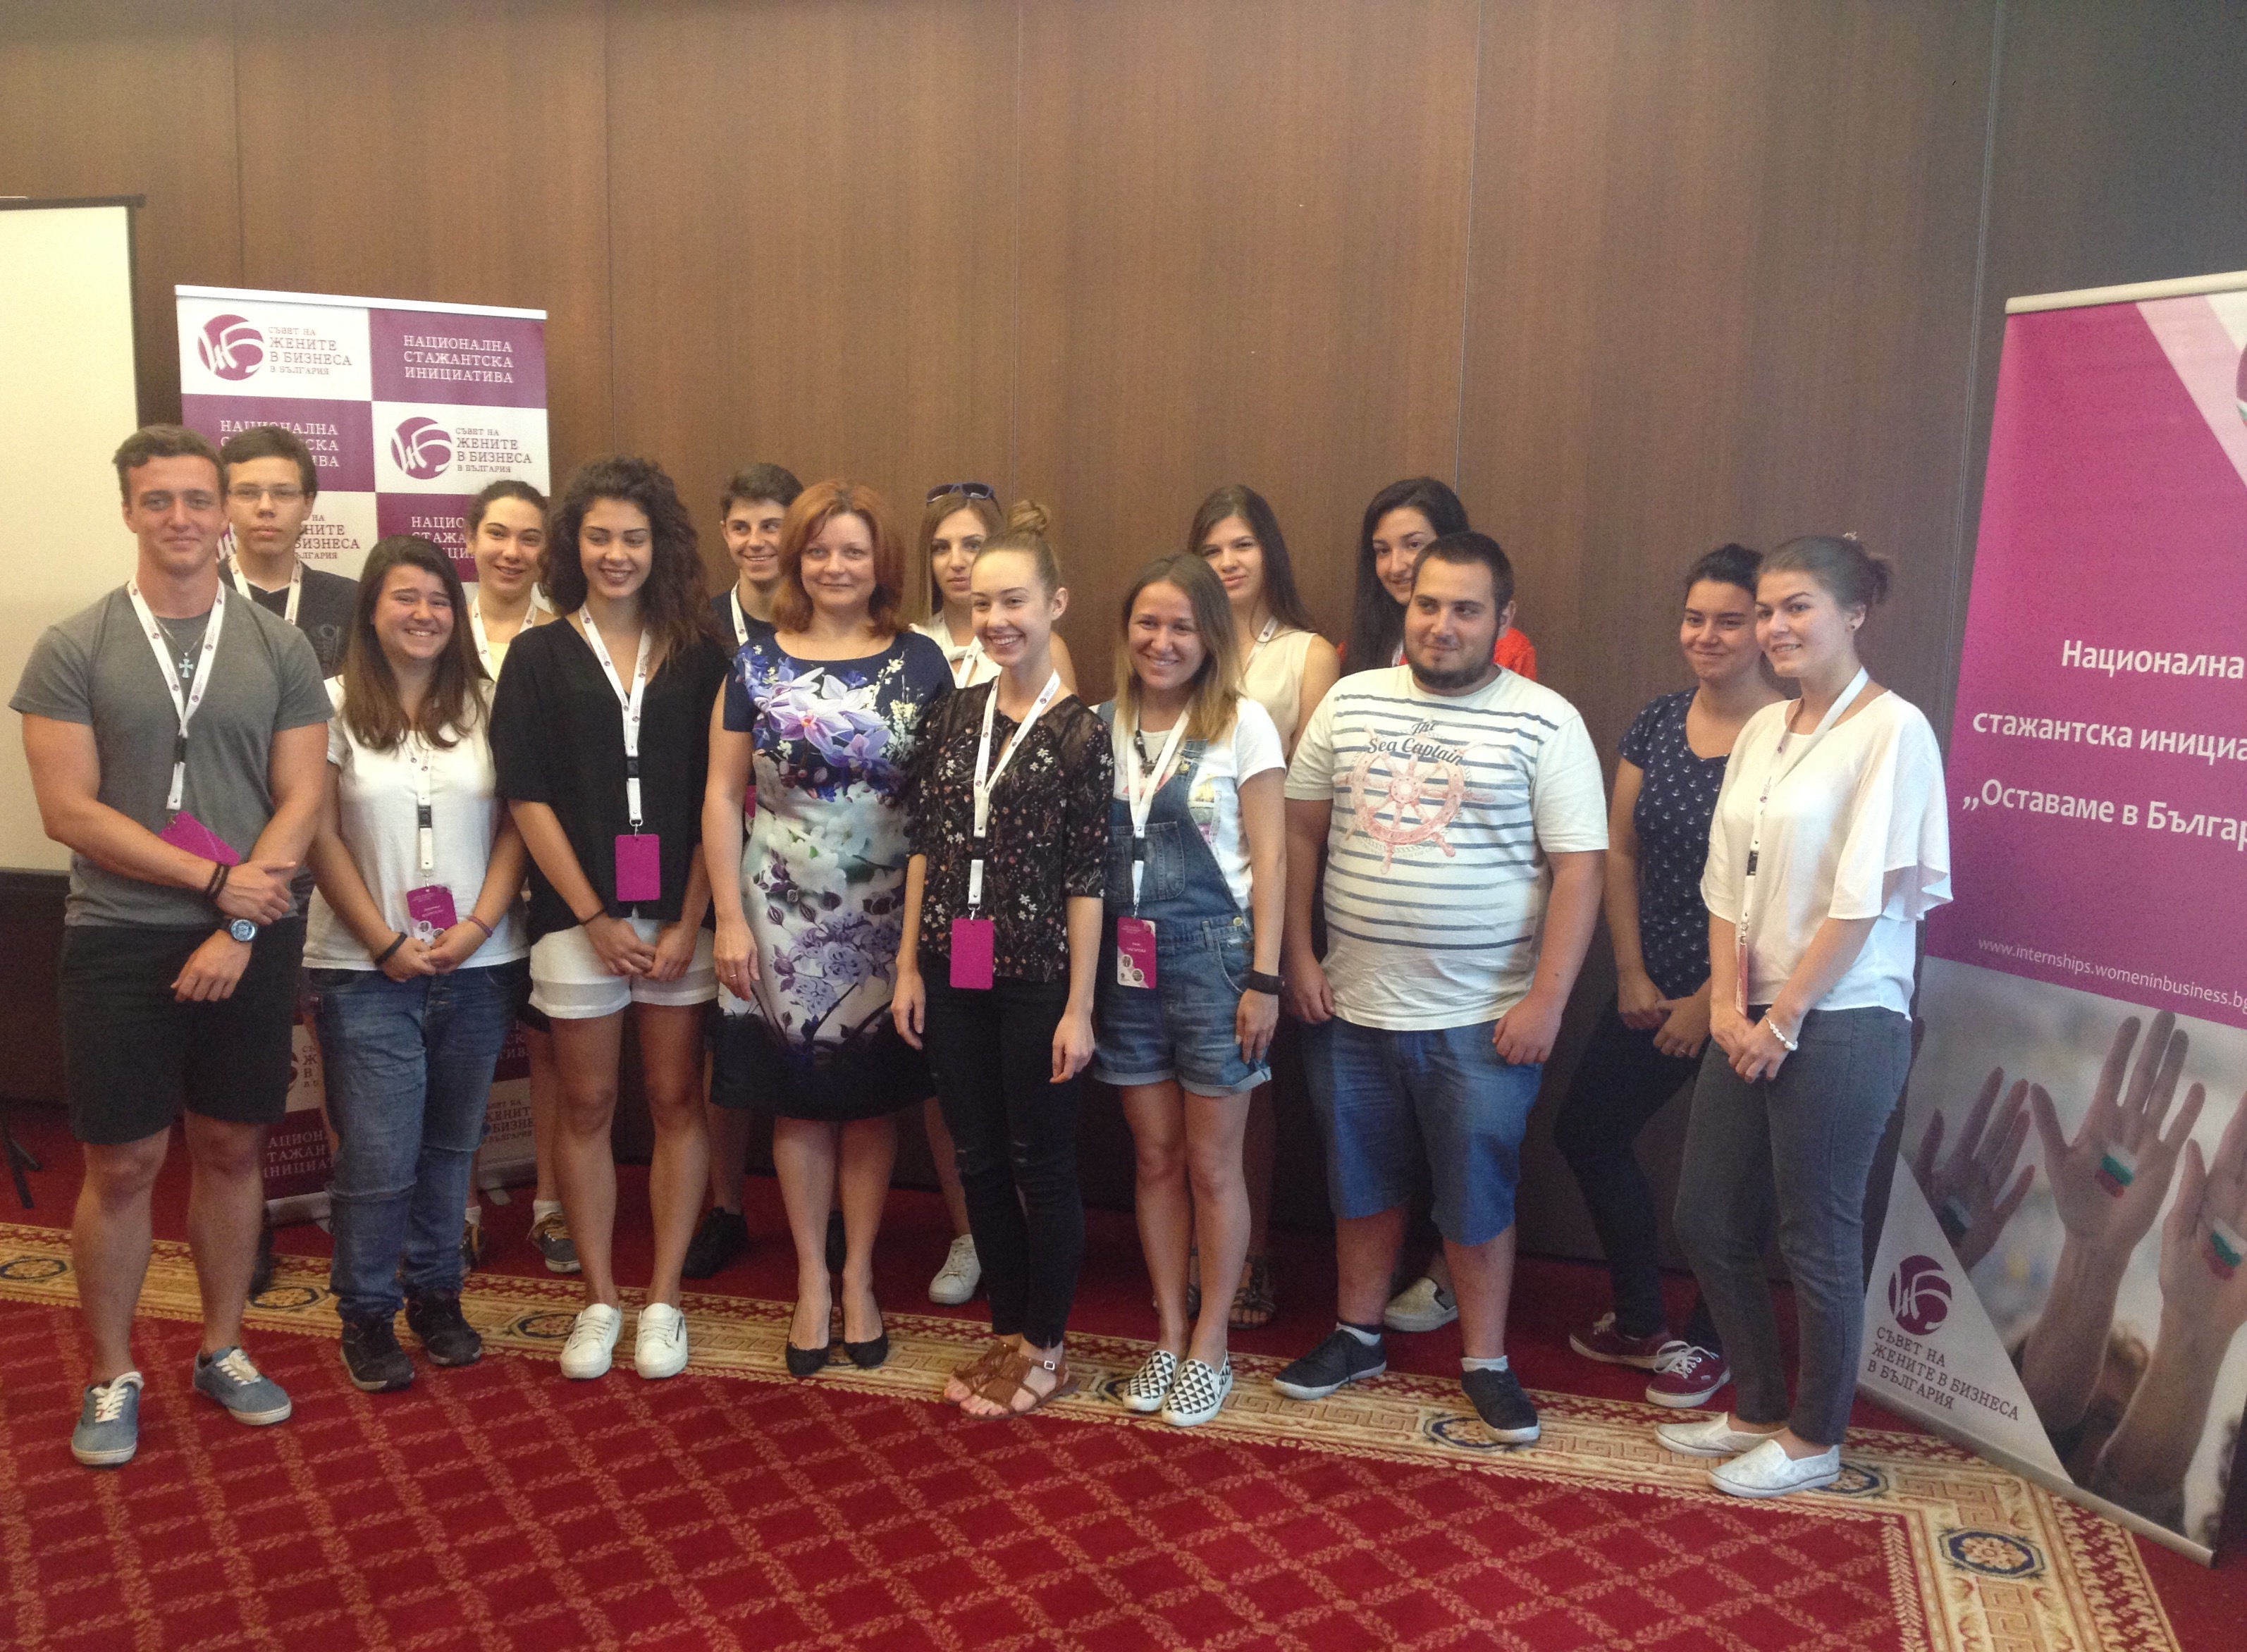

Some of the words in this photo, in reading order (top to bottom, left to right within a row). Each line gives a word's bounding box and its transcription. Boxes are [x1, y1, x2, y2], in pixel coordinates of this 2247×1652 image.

[268, 326, 299, 335] СЪВЕТ
[269, 337, 337, 351] ЖЕНИТЕ
[403, 335, 513, 352] НАЦИОНАЛНА
[269, 351, 278, 362] В
[283, 352, 352, 366] БИЗНЕСА
[404, 351, 514, 368] СТАЖАНТСКА
[279, 366, 330, 375] БЪЛГАРИЯ
[405, 366, 514, 383] ИНИЦИАТИВА
[456, 438, 518, 450] ЖЕНИТЕ
[457, 451, 465, 462] В
[469, 452, 532, 464] БИЗНЕСА
[465, 464, 512, 473] БЪЛГАРИЯ
[304, 524, 345, 536] НИТЕ
[411, 516, 465, 529] НАЦИО
[2062, 639, 2245, 678] Национална
[1412, 720, 1439, 736] The
[1973, 713, 2133, 748] стажантска
[1367, 738, 1398, 754] Sea
[1402, 737, 1464, 766] Captain
[2122, 804, 2138, 825] в
[493, 1118, 536, 1133] БИЗНЕ
[1876, 1326, 1922, 1355] СЪВЕТ
[1926, 1348, 1946, 1368] НА
[1867, 1359, 1877, 1373] В
[1880, 1365, 1955, 1410] БЪЛГАРИЯ
[1871, 1342, 1936, 1381] ЖЕНИТЕ
[1937, 1371, 1948, 1386] В
[1950, 1377, 2019, 1422] БИЗНЕСА
